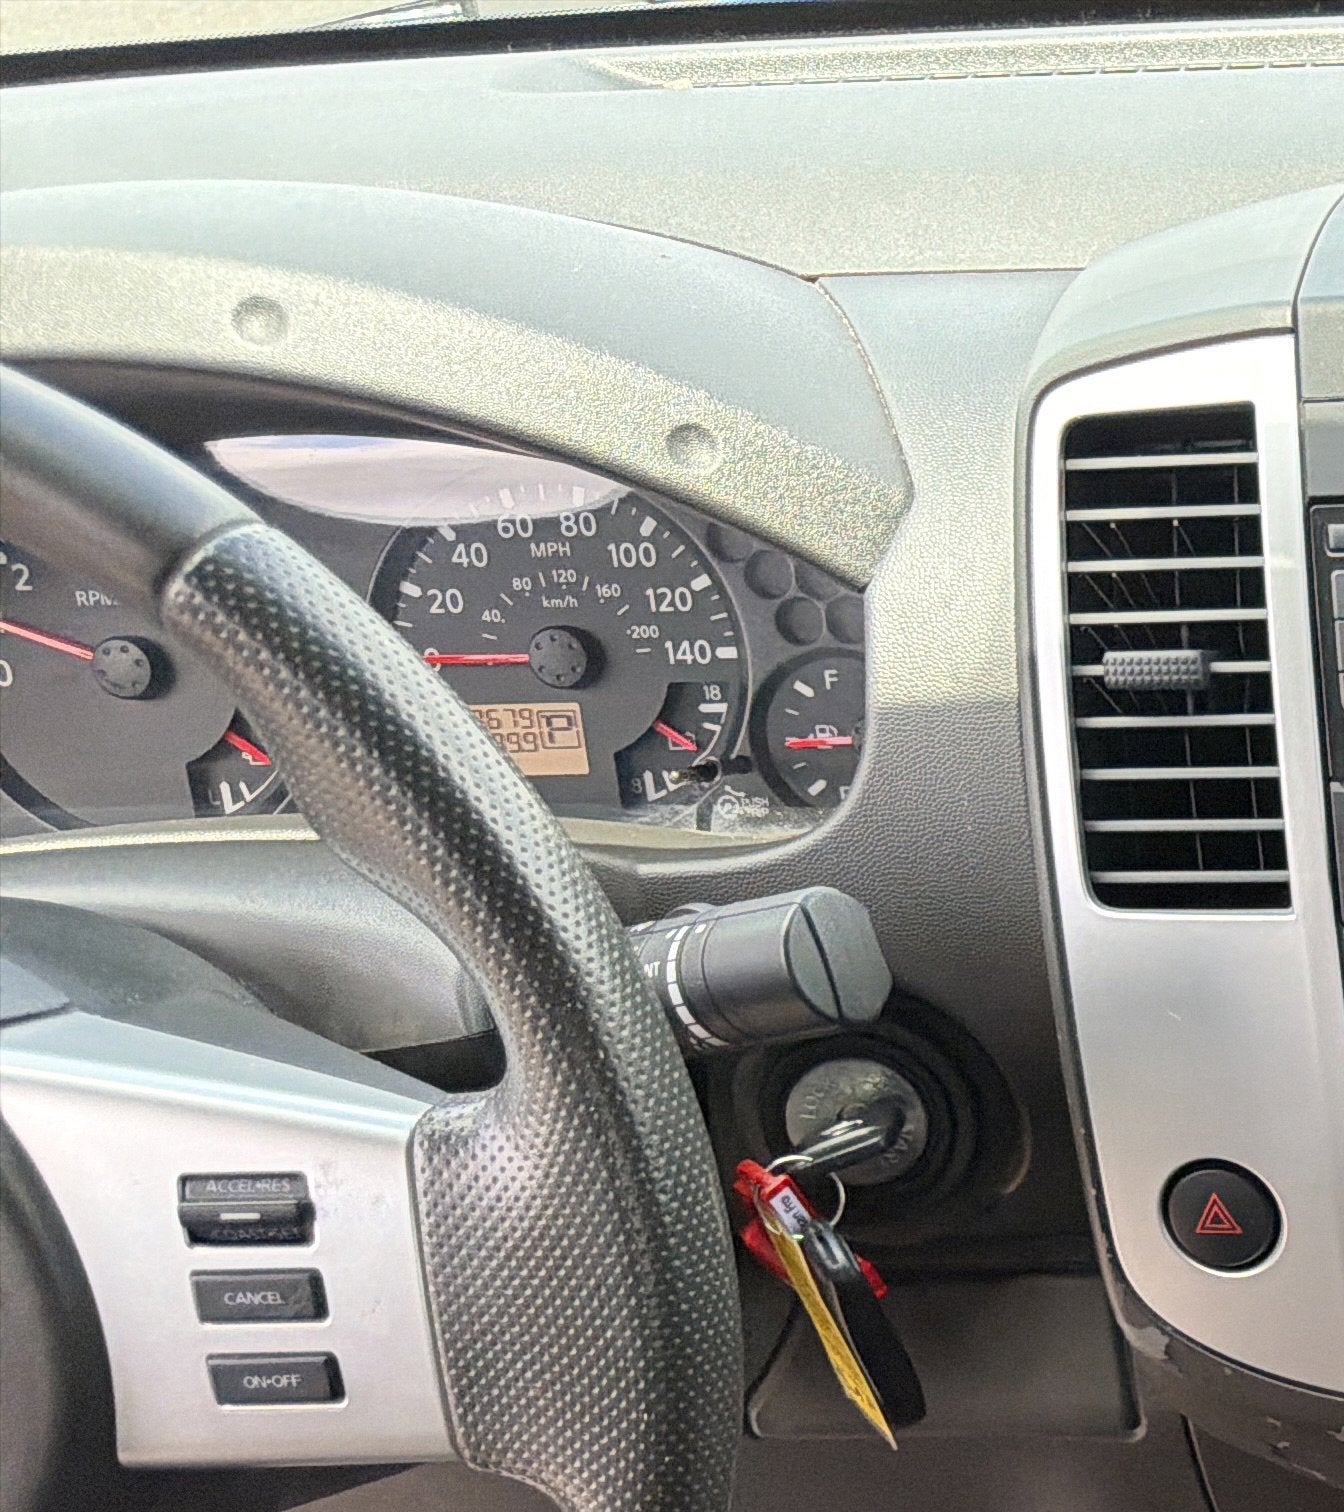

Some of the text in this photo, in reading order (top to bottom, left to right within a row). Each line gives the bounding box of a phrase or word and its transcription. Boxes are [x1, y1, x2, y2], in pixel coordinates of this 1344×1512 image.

[496, 514, 534, 538] 60
[559, 512, 597, 537] 80
[451, 542, 488, 568] 40
[530, 542, 571, 557] MPH
[606, 543, 657, 568] 100
[11, 562, 33, 591] 2
[512, 578, 532, 591] 80
[552, 570, 577, 584] 120
[429, 588, 464, 614] 20
[595, 585, 621, 597] 160
[646, 587, 692, 613] 120
[542, 596, 578, 608] km/h
[482, 610, 502, 623] 40
[630, 626, 660, 639] 200
[664, 641, 712, 665] 140
[823, 669, 838, 690] F
[702, 685, 722, 700] 18
[545, 714, 573, 743] P
[224, 1291, 284, 1305] CANCEL
